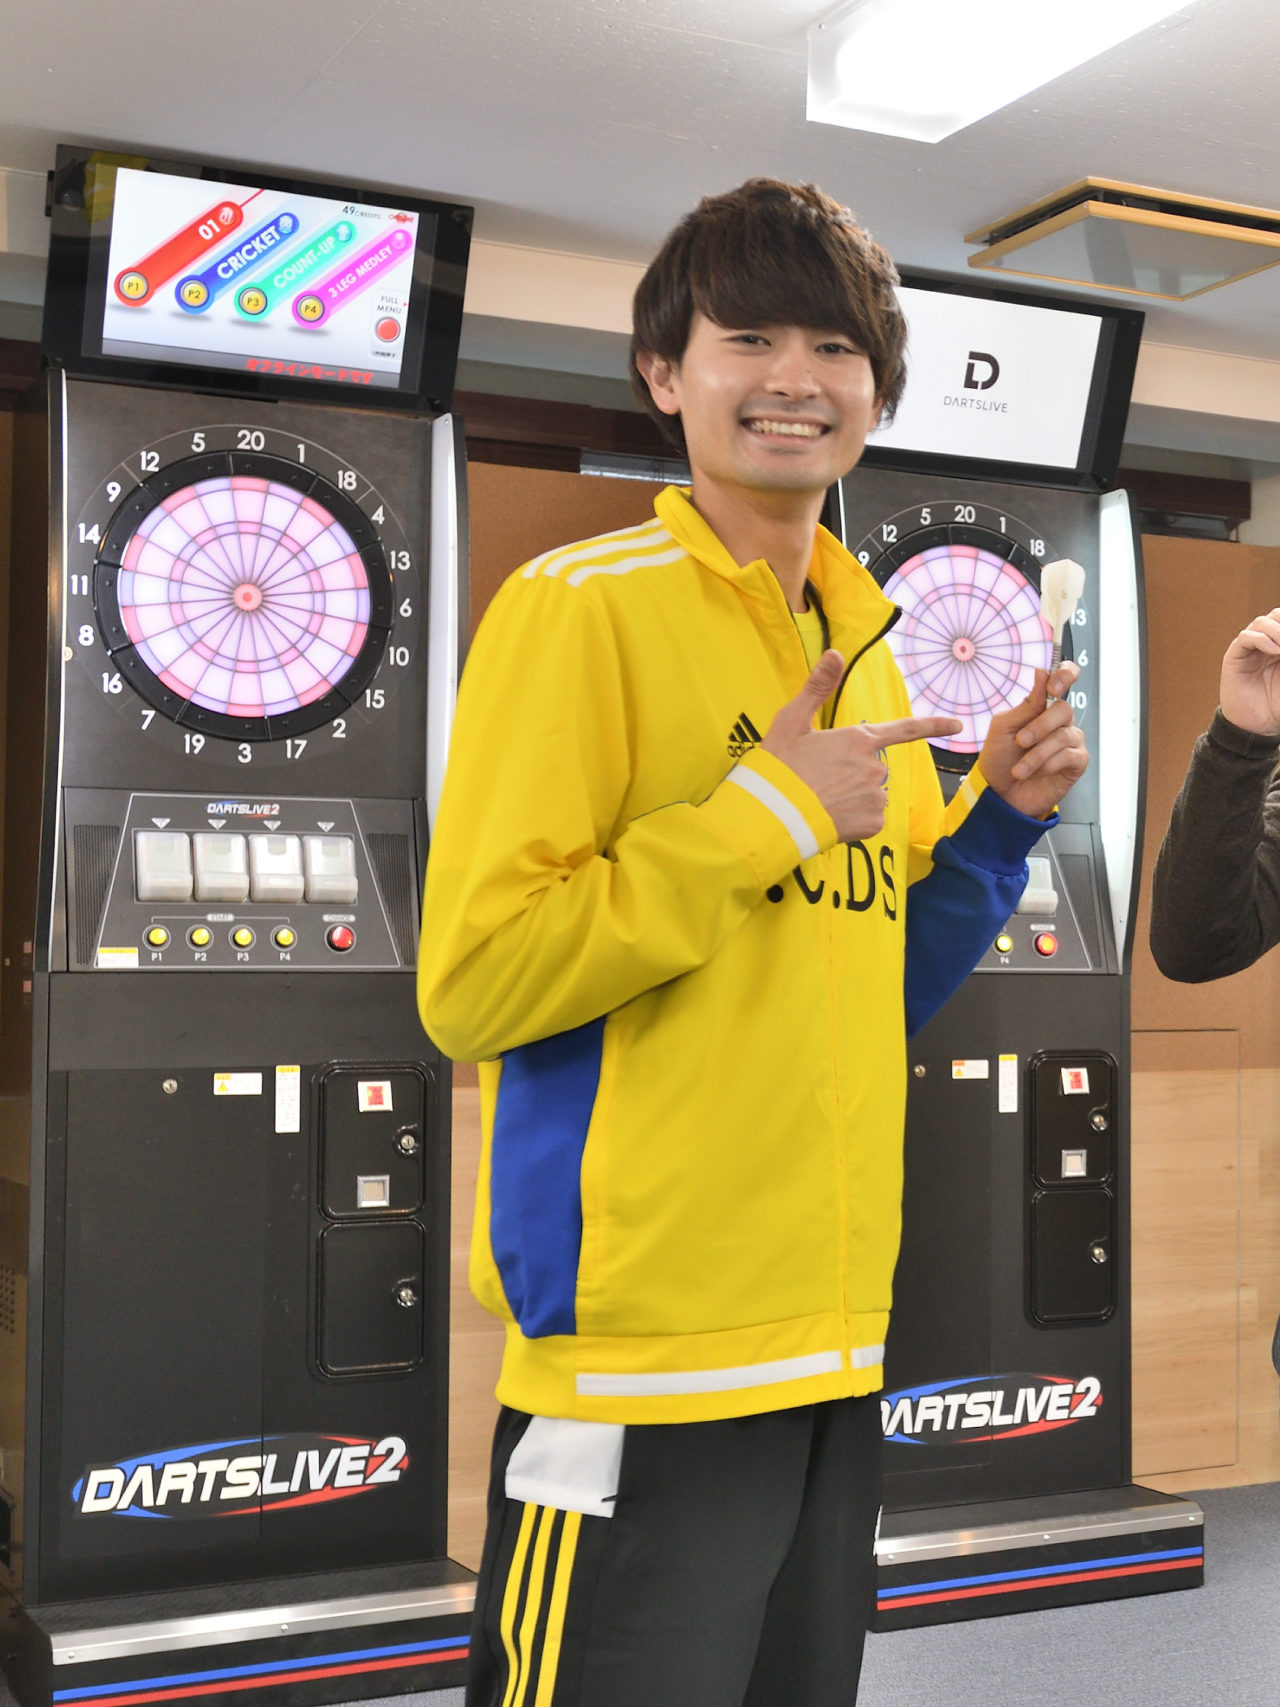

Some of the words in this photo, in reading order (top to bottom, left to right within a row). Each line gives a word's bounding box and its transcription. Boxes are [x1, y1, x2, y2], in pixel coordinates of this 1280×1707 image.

[342, 205, 355, 216] 49
[355, 210, 381, 221] CREDITS
[198, 218, 221, 241] 01
[217, 225, 281, 279] CRICKET
[273, 235, 337, 289] COUNT-UP
[328, 287, 337, 299] 3
[336, 273, 357, 293] LEG
[355, 245, 393, 279] MEDLEY
[127, 281, 139, 292] P1
[188, 288, 201, 299] P2
[247, 296, 260, 307] P3
[304, 303, 317, 315] P4
[376, 304, 402, 314] MENU
[381, 295, 398, 304] FULL
[943, 395, 1008, 413] DARTSLIVE
[191, 432, 205, 453] 5
[237, 430, 265, 450] 20
[140, 451, 159, 472] 12
[297, 444, 305, 463] 1
[338, 470, 357, 490] 18
[107, 482, 121, 503] 9
[372, 506, 385, 525] 4
[920, 508, 931, 525] 5
[954, 505, 976, 523] 20
[78, 523, 100, 545] 14
[882, 524, 897, 543] 12
[999, 517, 1006, 533] 1
[1030, 539, 1045, 557] 18
[390, 551, 411, 571] 13
[858, 551, 870, 567] 9
[71, 574, 88, 595] 11
[400, 598, 412, 617] 6
[1071, 608, 1087, 626] 13
[79, 625, 94, 646] 8
[390, 647, 410, 667] 10
[1078, 649, 1088, 667] 6
[102, 672, 122, 694] 16
[366, 689, 385, 709] 15
[1070, 691, 1087, 709] 10
[142, 710, 156, 731] 7
[332, 719, 346, 738] 2
[184, 733, 205, 755] 19
[238, 743, 252, 764] 3
[286, 740, 308, 759] 17
[727, 740, 756, 758] adi
[207, 802, 280, 816] DARTSLIVE2
[151, 952, 162, 962] P1
[194, 952, 207, 962] P2
[237, 952, 249, 962] P3
[279, 952, 291, 962] P4
[81, 1436, 407, 1514] DARTSLIVE2
